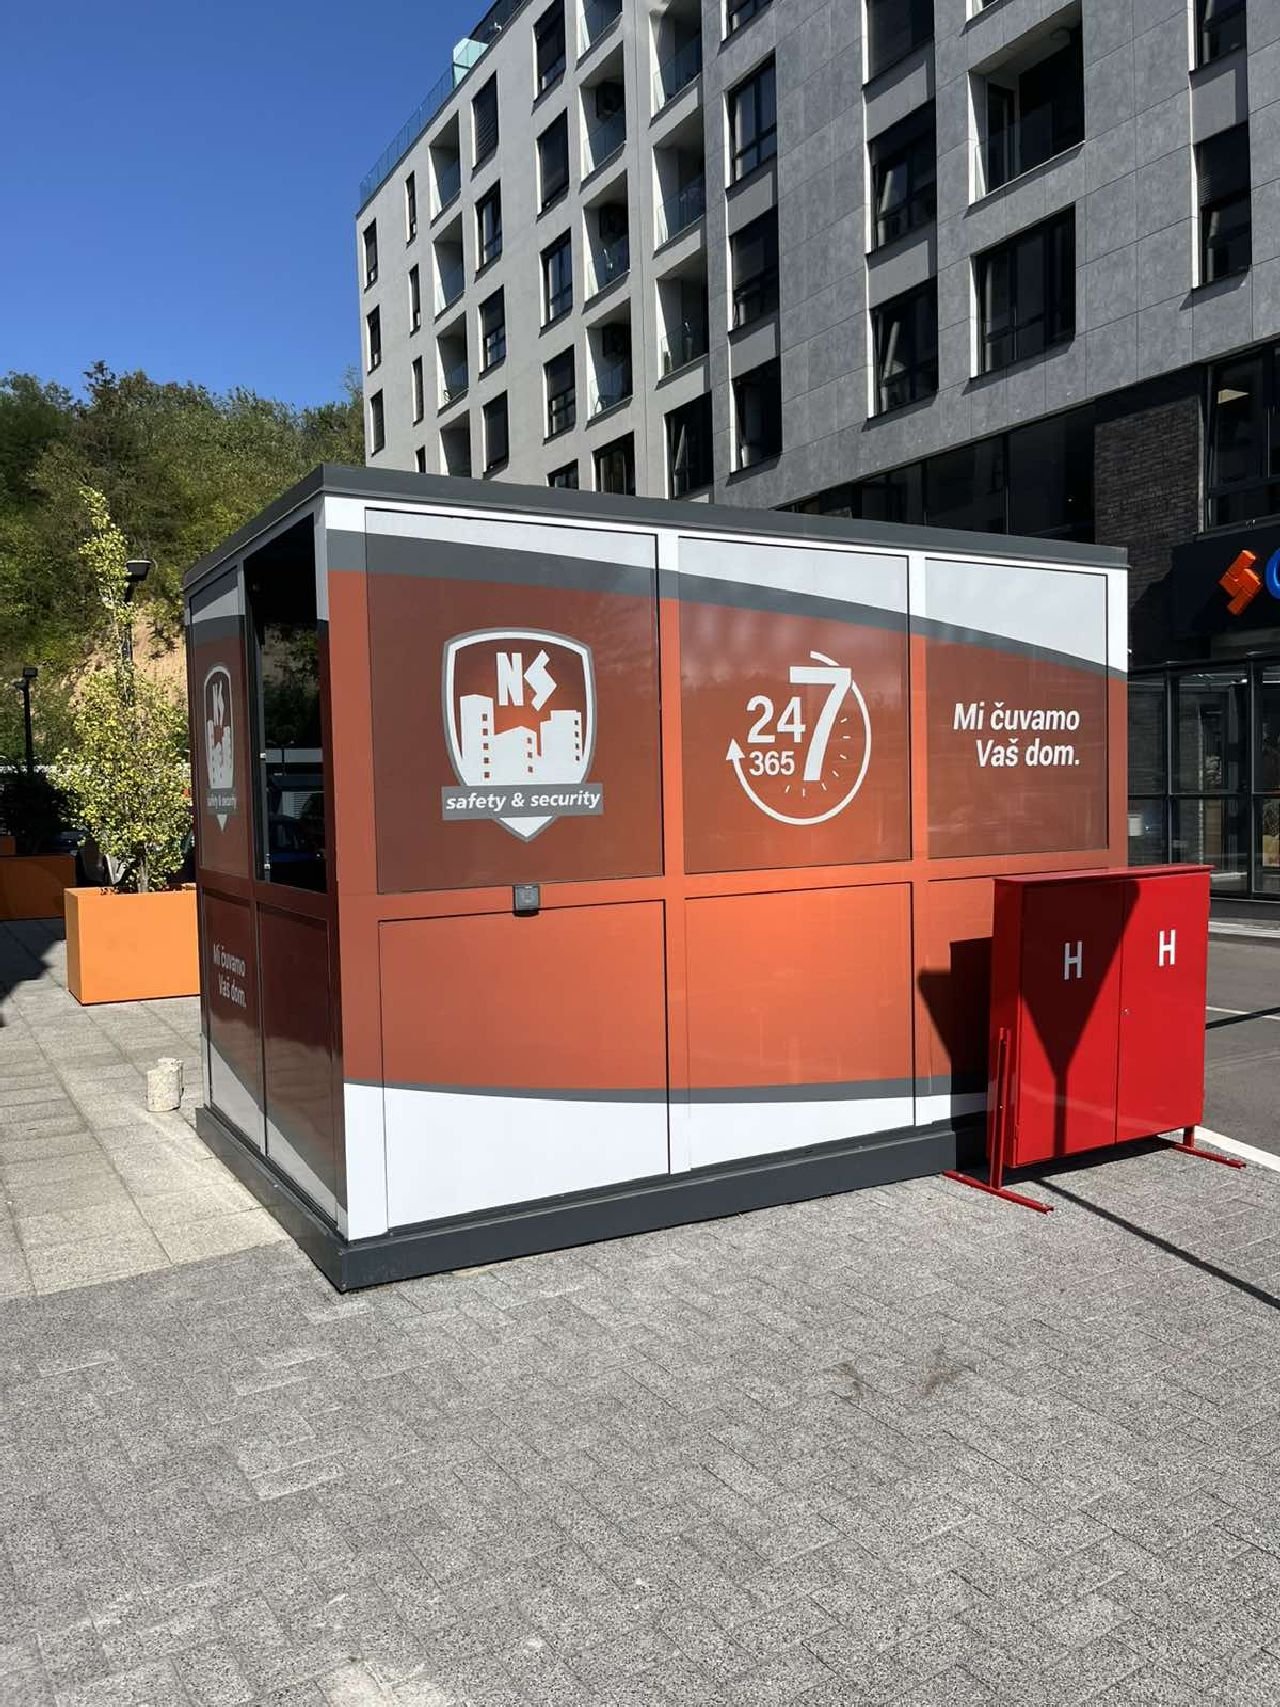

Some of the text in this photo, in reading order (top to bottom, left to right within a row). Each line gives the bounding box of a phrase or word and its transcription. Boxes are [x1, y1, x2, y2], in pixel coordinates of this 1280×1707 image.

[495, 650, 557, 711] NS
[746, 666, 852, 781] 24 7
[953, 701, 1080, 731] Mi čuvamo
[748, 750, 795, 776] 365
[976, 737, 1081, 768] Vaš dom.
[446, 791, 601, 812] safety & security
[1064, 940, 1083, 980] H
[1158, 929, 1176, 967] H
